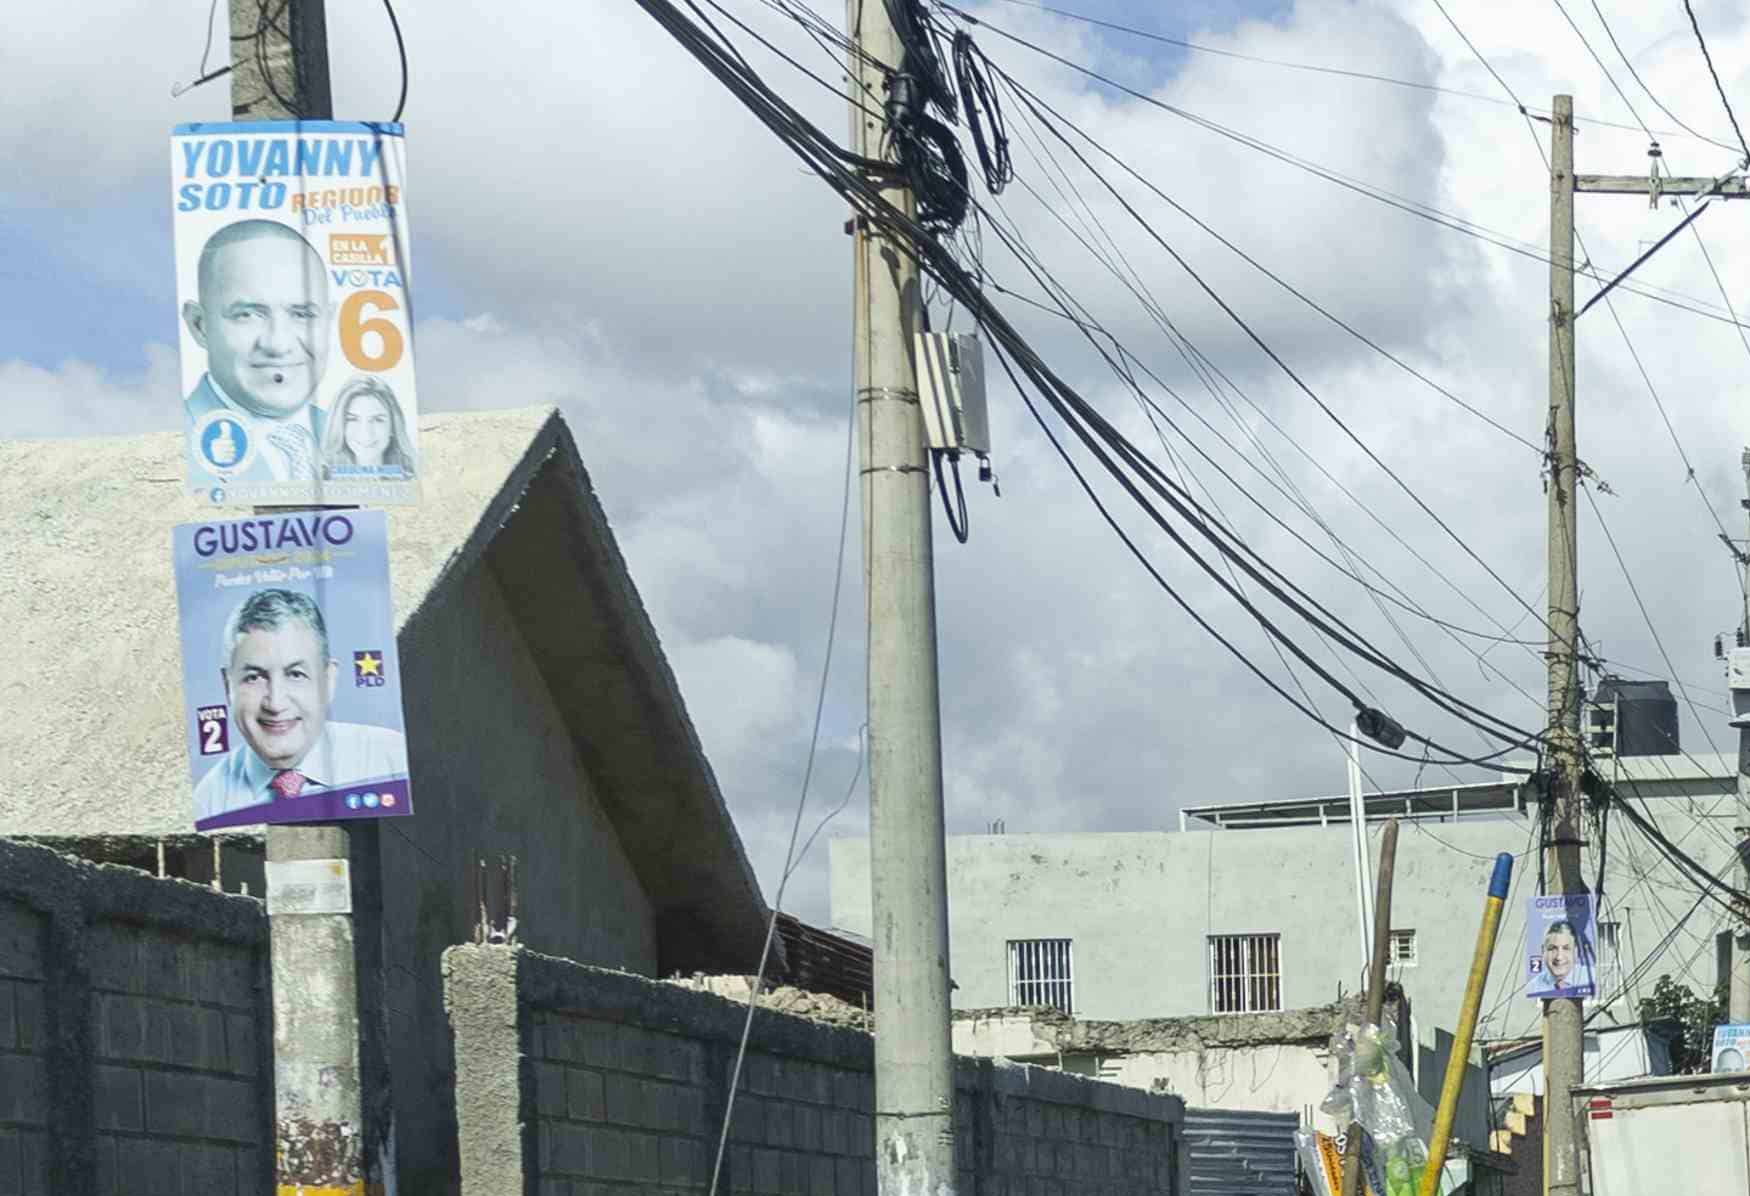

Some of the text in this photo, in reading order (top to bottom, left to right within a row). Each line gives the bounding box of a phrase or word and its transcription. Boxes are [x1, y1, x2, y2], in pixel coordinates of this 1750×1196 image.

[182, 139, 377, 178] YOVANNY
[177, 182, 287, 212] SOTO
[331, 269, 402, 288] VOTA
[338, 289, 404, 373] 6
[194, 515, 353, 557] GUSTAVO
[356, 676, 385, 688] PLD
[199, 707, 227, 721] VOTA
[203, 720, 224, 753] 2
[1536, 897, 1586, 909] GUSTAVO
[1531, 960, 1540, 972] 2
